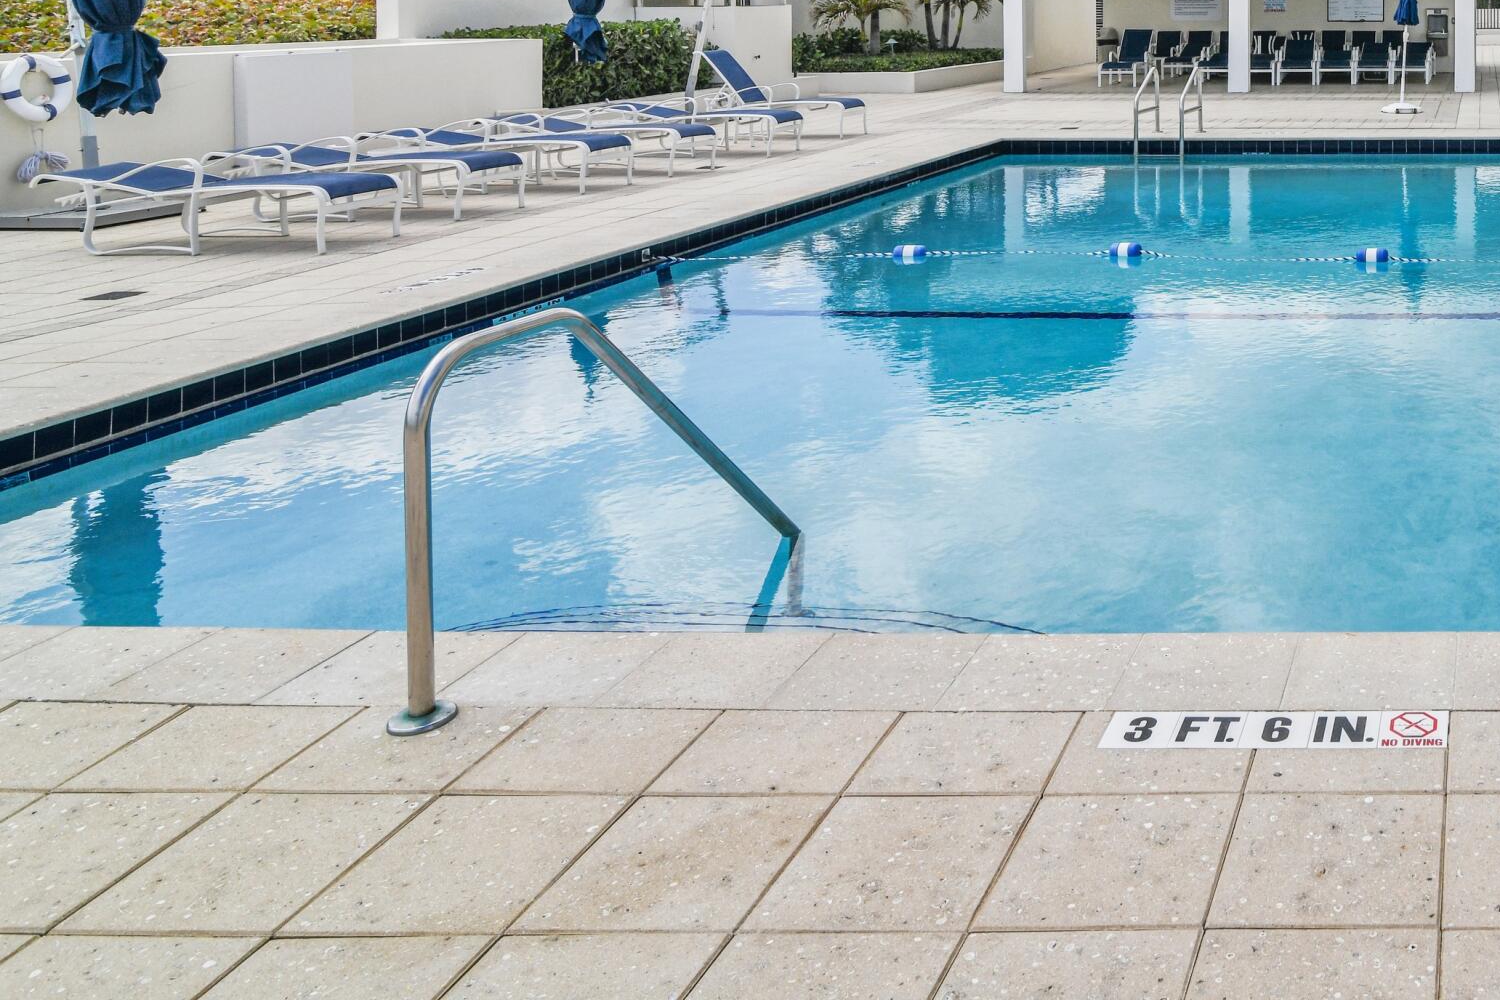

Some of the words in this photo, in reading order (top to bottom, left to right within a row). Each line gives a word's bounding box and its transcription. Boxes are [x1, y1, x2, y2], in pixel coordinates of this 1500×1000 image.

[1123, 716, 1157, 743] 3
[1174, 716, 1241, 743] FT.
[1260, 716, 1293, 743] 6
[1312, 715, 1375, 743] IN.
[1381, 738, 1398, 747] NO
[1402, 738, 1443, 747] DIVING
